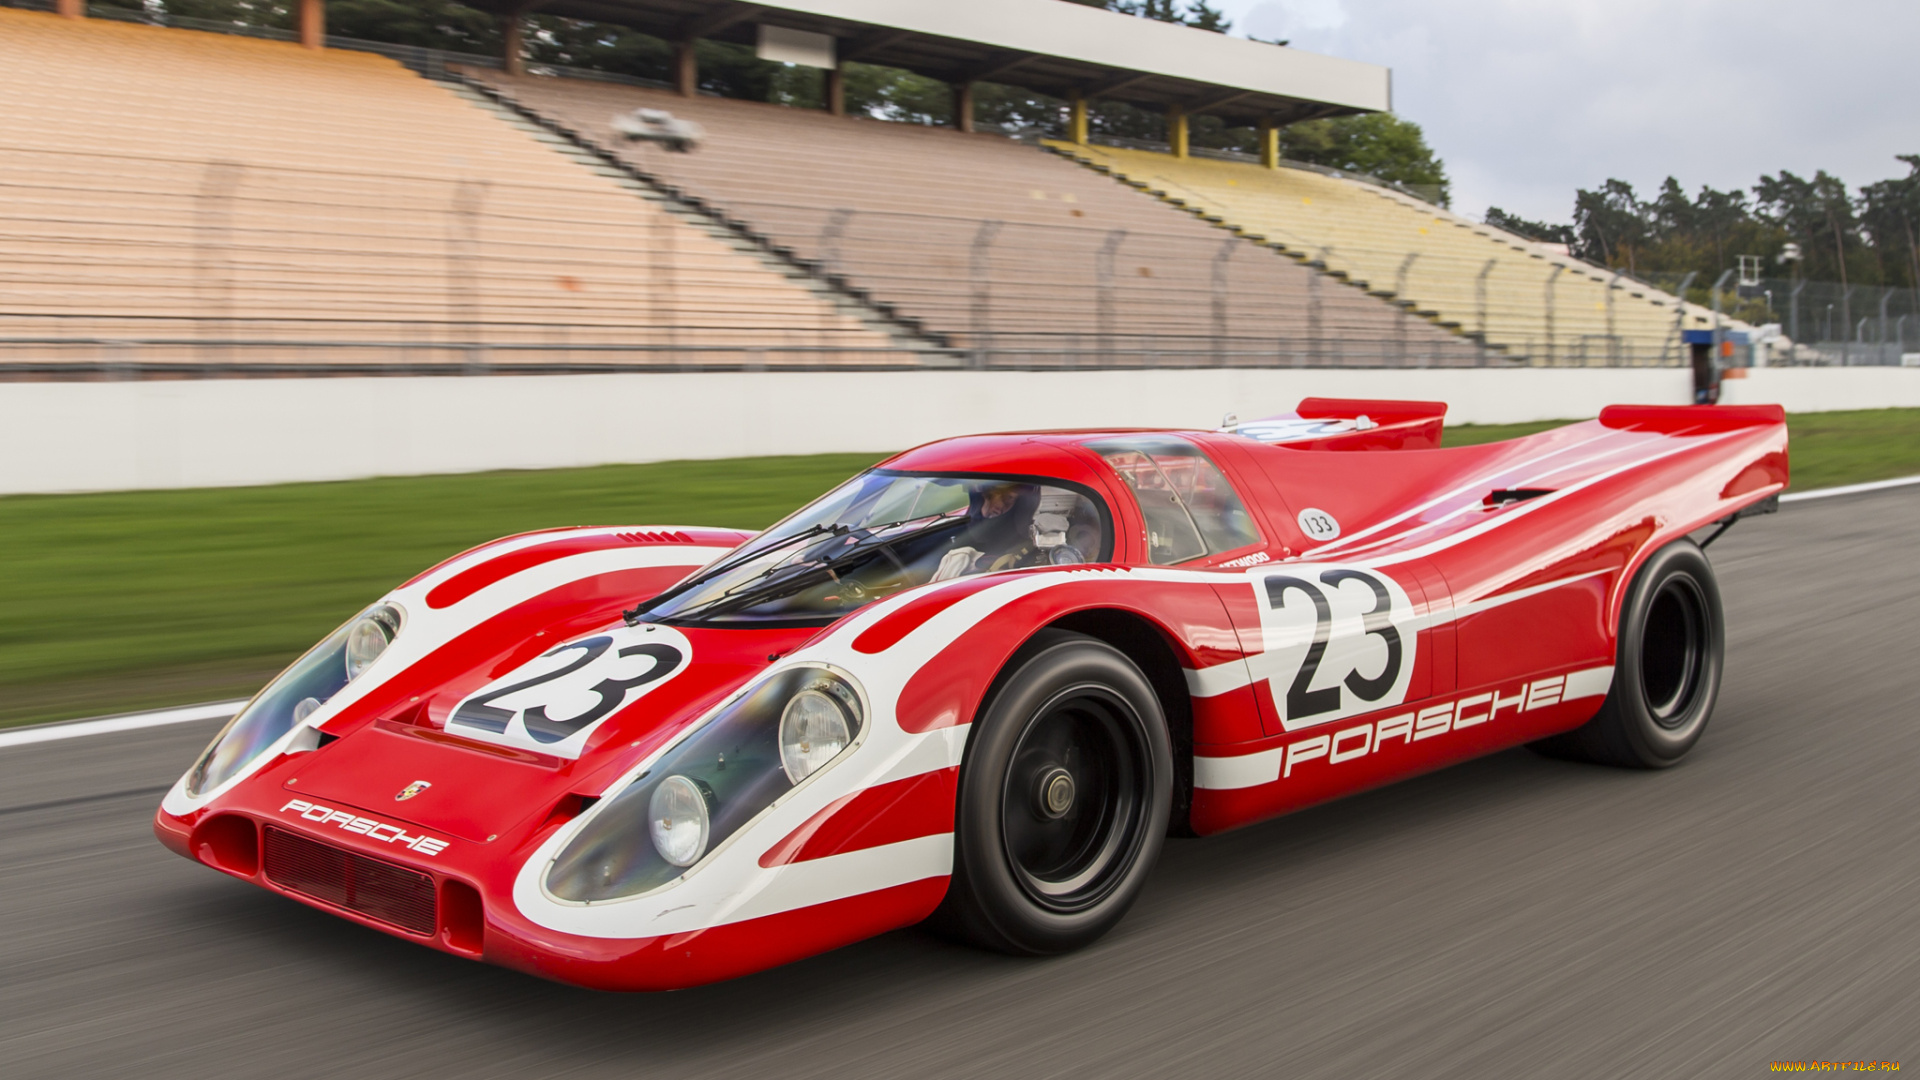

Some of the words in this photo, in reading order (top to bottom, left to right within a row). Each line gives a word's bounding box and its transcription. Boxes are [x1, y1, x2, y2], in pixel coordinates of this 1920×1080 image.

[1303, 515, 1333, 535] 133
[451, 636, 683, 744] 23
[1264, 568, 1403, 721] 23
[1282, 675, 1565, 778] PORSCHE
[279, 799, 450, 856] PORSCHE
